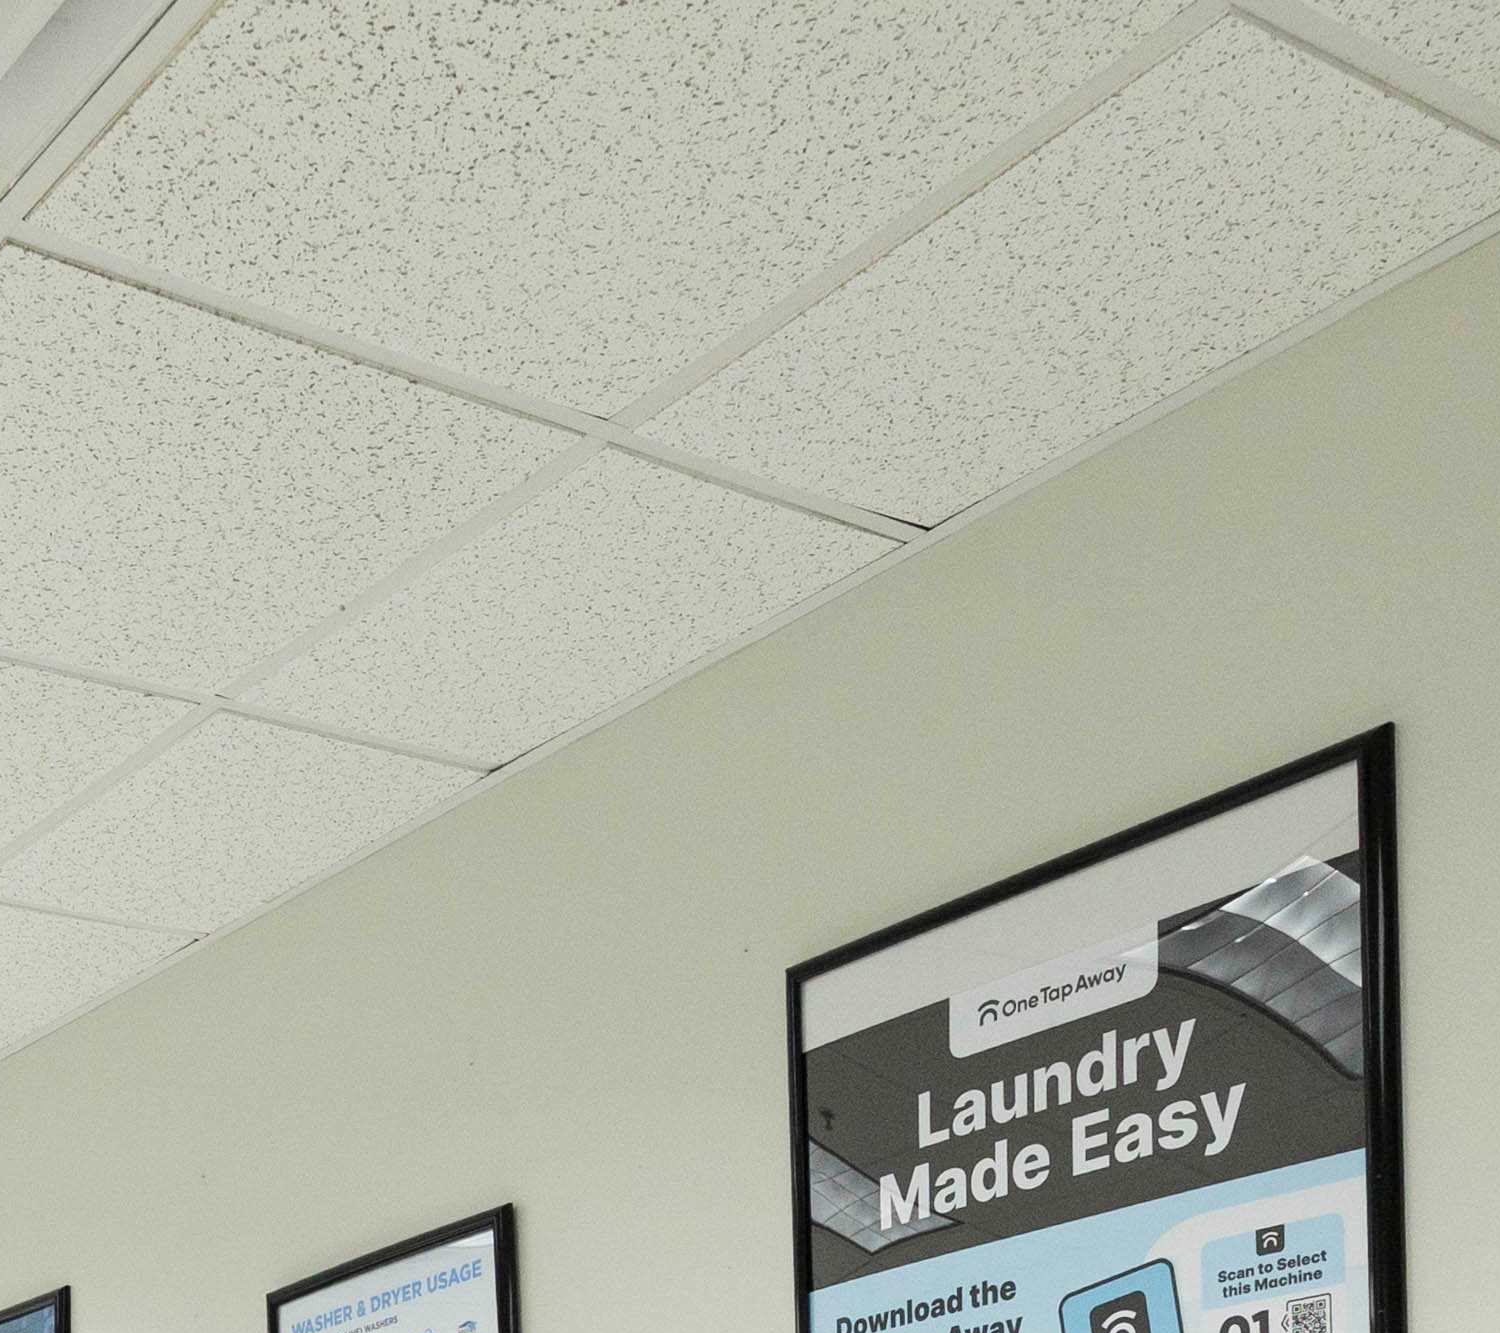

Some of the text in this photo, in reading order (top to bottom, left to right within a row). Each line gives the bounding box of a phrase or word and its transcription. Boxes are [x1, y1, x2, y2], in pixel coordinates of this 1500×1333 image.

[918, 1019, 1197, 1149] Laundry
[880, 1084, 1246, 1231] Made Easy
[1218, 1250, 1327, 1283] Scan to Select
[356, 1299, 366, 1318] &
[370, 1279, 422, 1313] DRYER
[426, 1258, 482, 1294] USAGE
[970, 1280, 1016, 1306] the
[1222, 1269, 1323, 1298] this Machine
[364, 1314, 397, 1333] WASHERS
